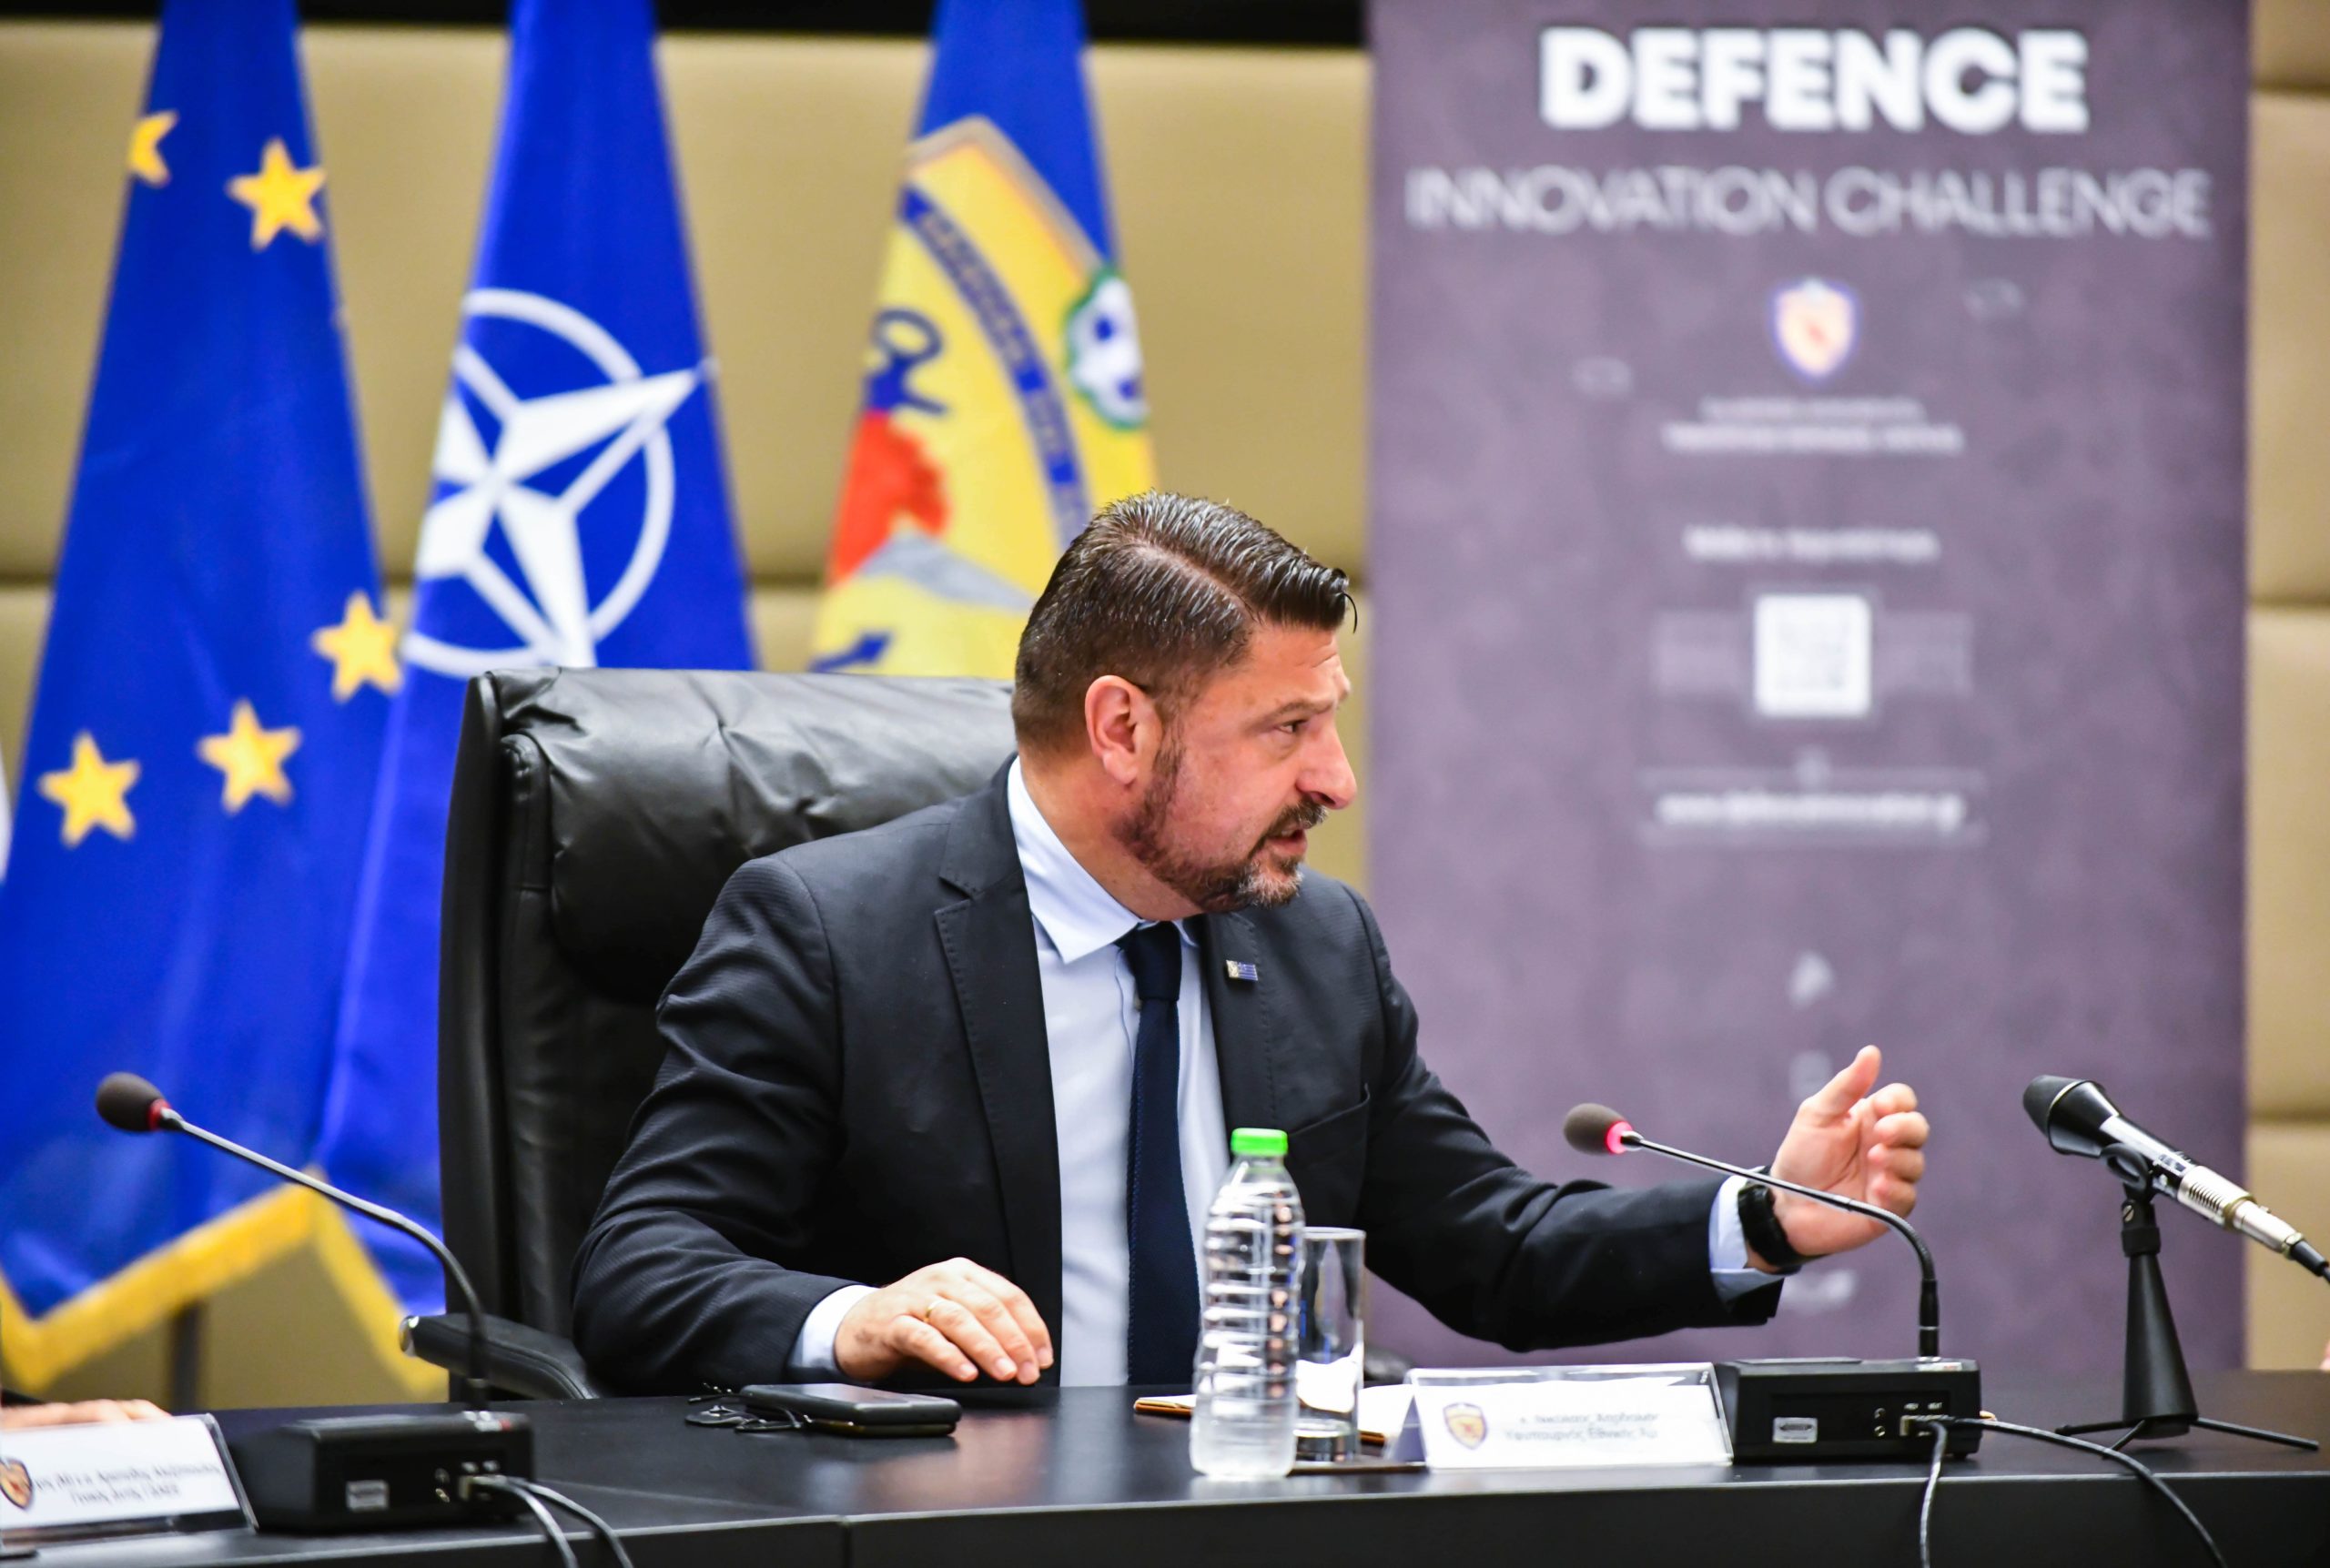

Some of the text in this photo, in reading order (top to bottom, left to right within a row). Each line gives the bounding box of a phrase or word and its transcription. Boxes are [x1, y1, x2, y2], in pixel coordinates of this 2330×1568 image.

[1539, 26, 2091, 133] DEFENCE
[1406, 165, 2214, 239] INNOVATION CHALLENGE
